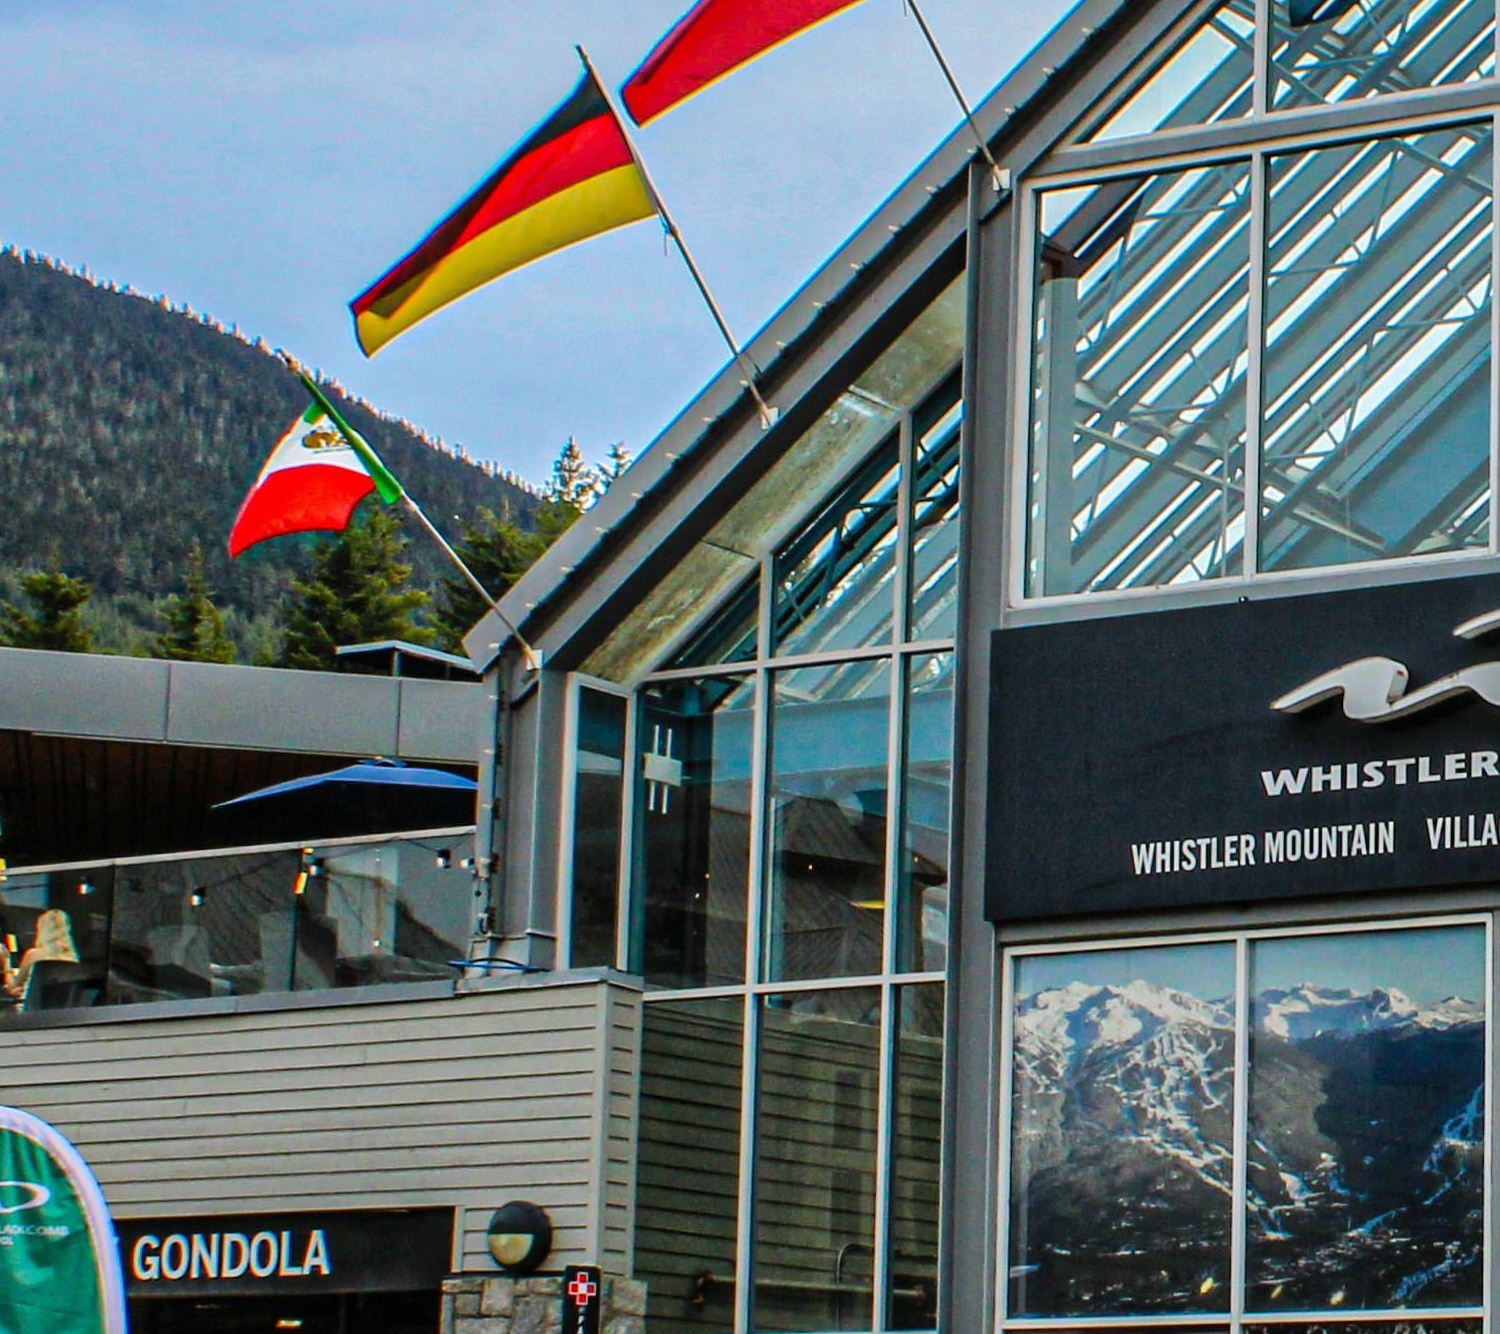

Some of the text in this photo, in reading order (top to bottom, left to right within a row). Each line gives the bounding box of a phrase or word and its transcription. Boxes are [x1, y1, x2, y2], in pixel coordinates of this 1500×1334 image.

[1261, 751, 1500, 797] WHISTLER
[1130, 834, 1257, 877] WHISTLER
[1263, 819, 1396, 865] MOUNTAIN
[132, 1228, 330, 1280] GONDOLA
